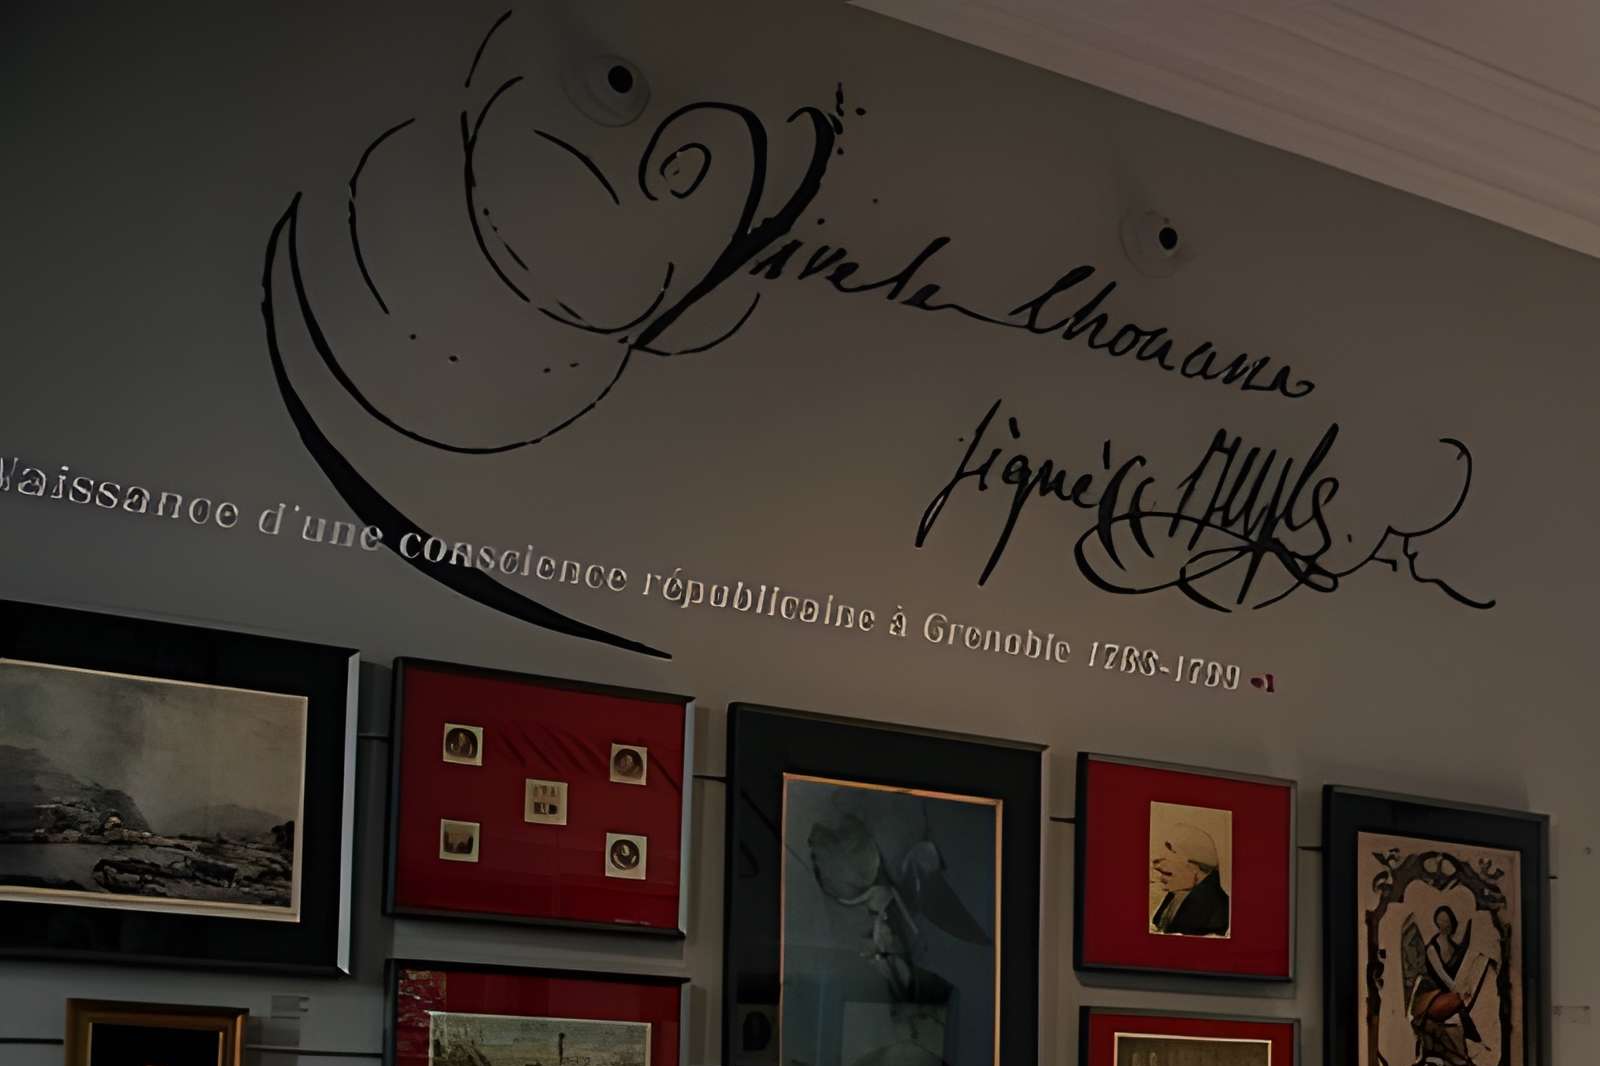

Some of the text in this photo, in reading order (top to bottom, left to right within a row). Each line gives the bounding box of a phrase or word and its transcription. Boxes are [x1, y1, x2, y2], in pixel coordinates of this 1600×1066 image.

[257, 502, 384, 552] d'une
[398, 530, 628, 592] conscience
[922, 612, 1072, 665] Grenoble
